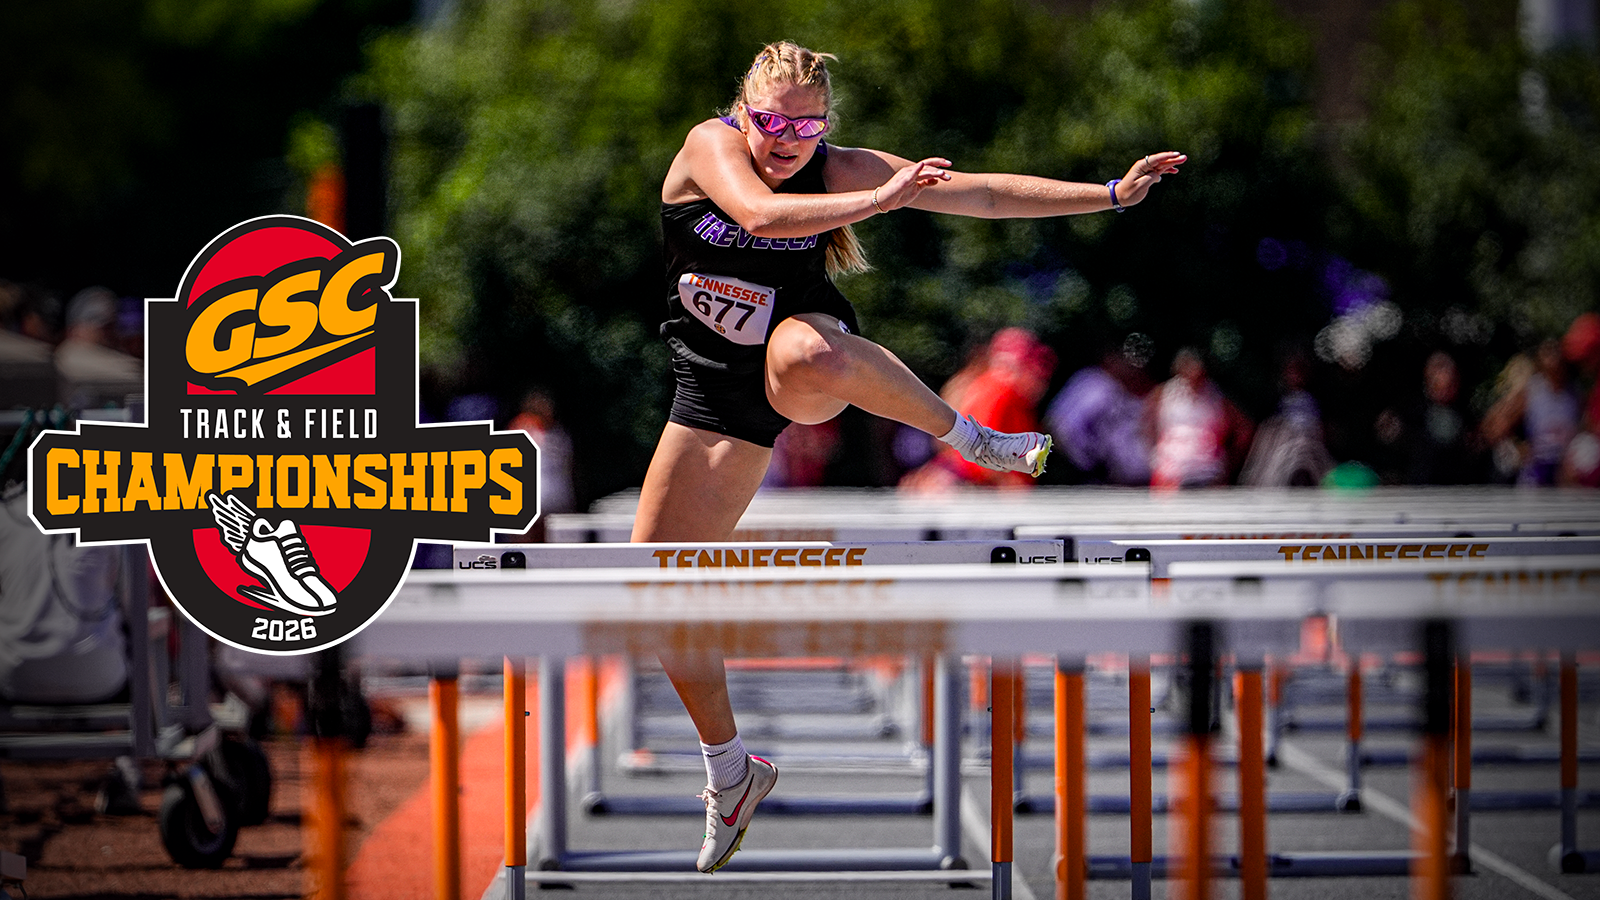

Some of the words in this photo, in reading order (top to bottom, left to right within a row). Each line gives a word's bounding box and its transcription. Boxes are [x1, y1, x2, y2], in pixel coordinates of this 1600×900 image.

[688, 273, 768, 307] TENNESSEE
[693, 291, 756, 332] 677
[1019, 556, 1057, 564] UCS
[1085, 557, 1123, 565] UCS
[459, 561, 497, 570] UCS
